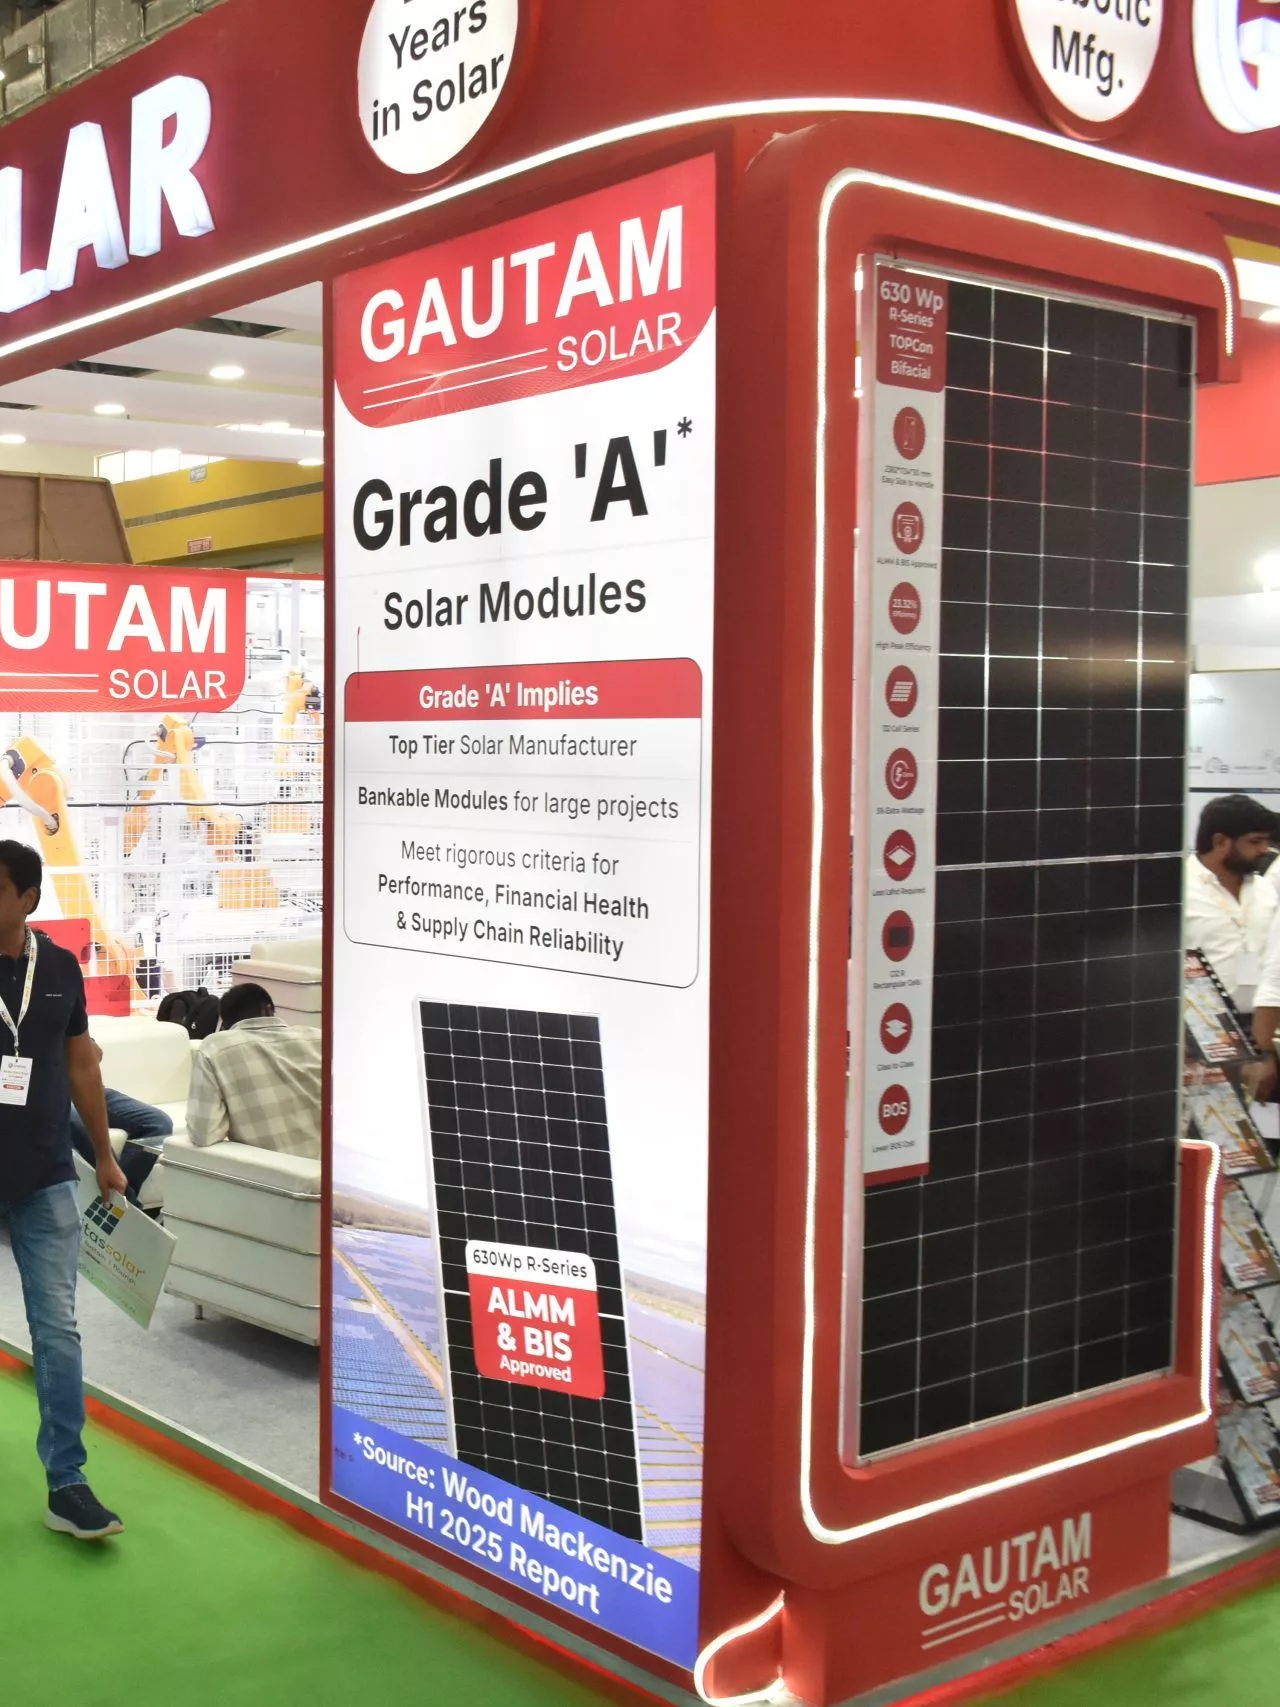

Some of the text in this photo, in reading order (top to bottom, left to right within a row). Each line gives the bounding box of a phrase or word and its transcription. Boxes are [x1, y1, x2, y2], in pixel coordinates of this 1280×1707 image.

[388, 0, 487, 70] Years
[1052, 25, 1123, 97] Mfg.
[372, 54, 504, 141] in Solar
[360, 205, 683, 363] GAUTAM
[880, 280, 944, 314] 630 Wp
[888, 306, 934, 328] R-Series
[556, 312, 683, 372] SOLAR
[889, 334, 934, 355] TOPCon
[891, 360, 932, 380] Bifacial
[353, 457, 548, 552] Grade
[383, 572, 646, 631] Solar Modules
[108, 668, 227, 700] SOLAR
[419, 680, 599, 712] Grade 'A' Implies
[389, 735, 637, 759] Top Tier Solar Manufacturer
[358, 786, 679, 822] Bankable Modules for large projects
[401, 840, 620, 876] Meet rigorous criteria for
[378, 874, 650, 920] Performance, Financial Health
[396, 911, 624, 961] & Supply Chain Reliability
[882, 1102, 908, 1118] BOS
[473, 1249, 588, 1279] 630Wp R-Series
[487, 1286, 576, 1328] ALMM
[497, 1321, 573, 1363] & BIS
[500, 1354, 572, 1383] Approved
[406, 1491, 601, 1614] H1 2025 Report
[442, 1466, 513, 1528] Wood
[520, 1504, 673, 1604] Mackenzie
[919, 1512, 1092, 1617] GAUTAM
[1008, 1566, 1090, 1622] SOLAR
